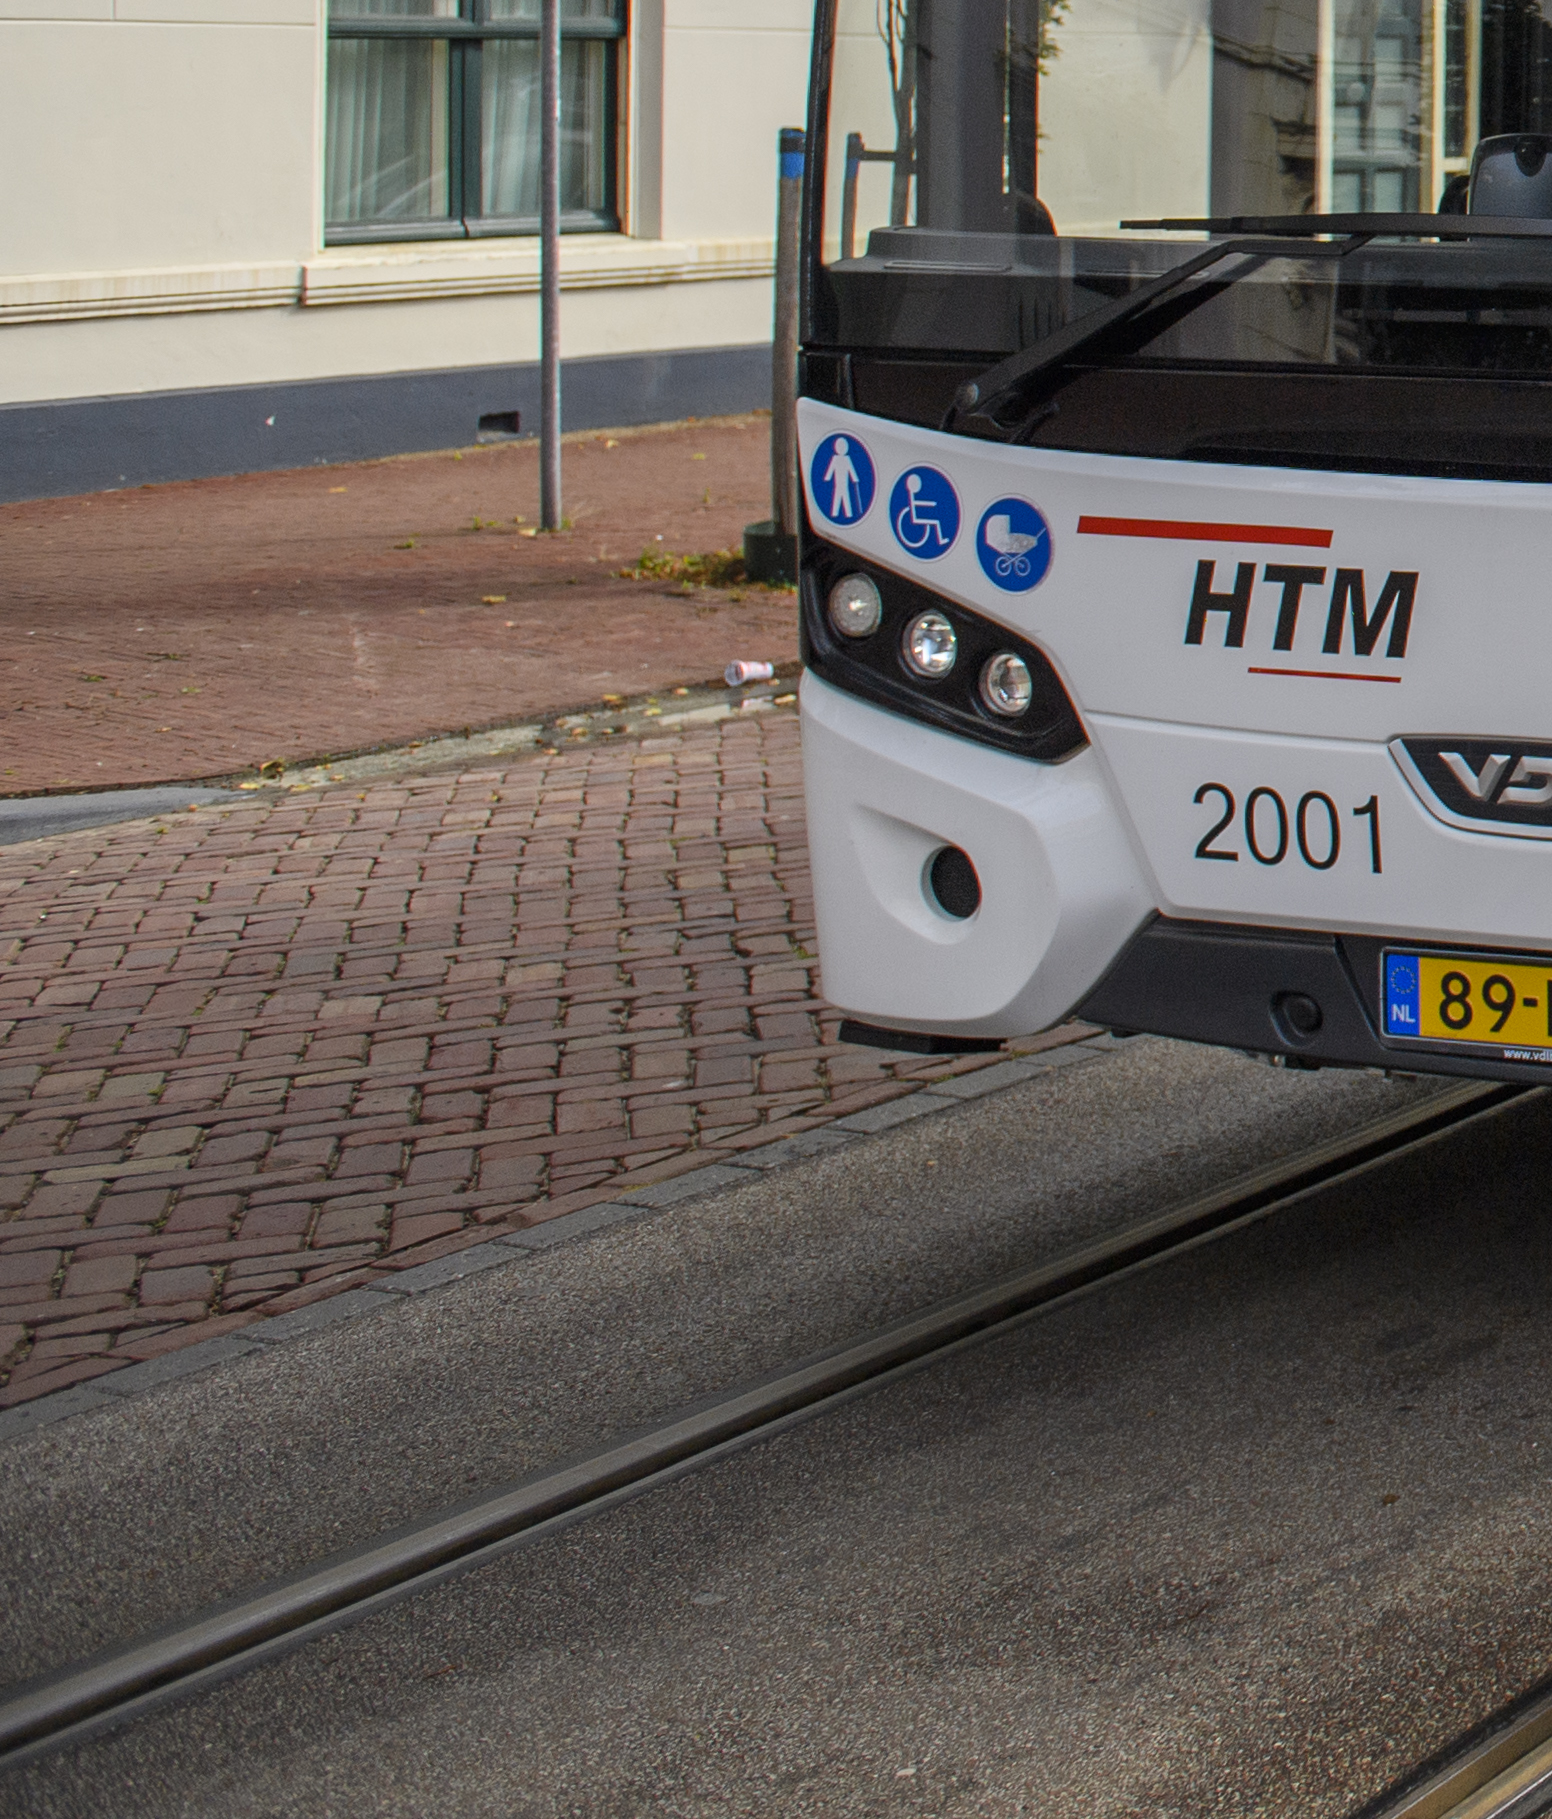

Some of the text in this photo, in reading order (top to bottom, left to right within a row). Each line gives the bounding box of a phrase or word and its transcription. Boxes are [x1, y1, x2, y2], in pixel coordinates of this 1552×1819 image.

[1183, 558, 1420, 660] HTM
[1192, 782, 1384, 875] 2001
[1391, 1003, 1417, 1024] NL
